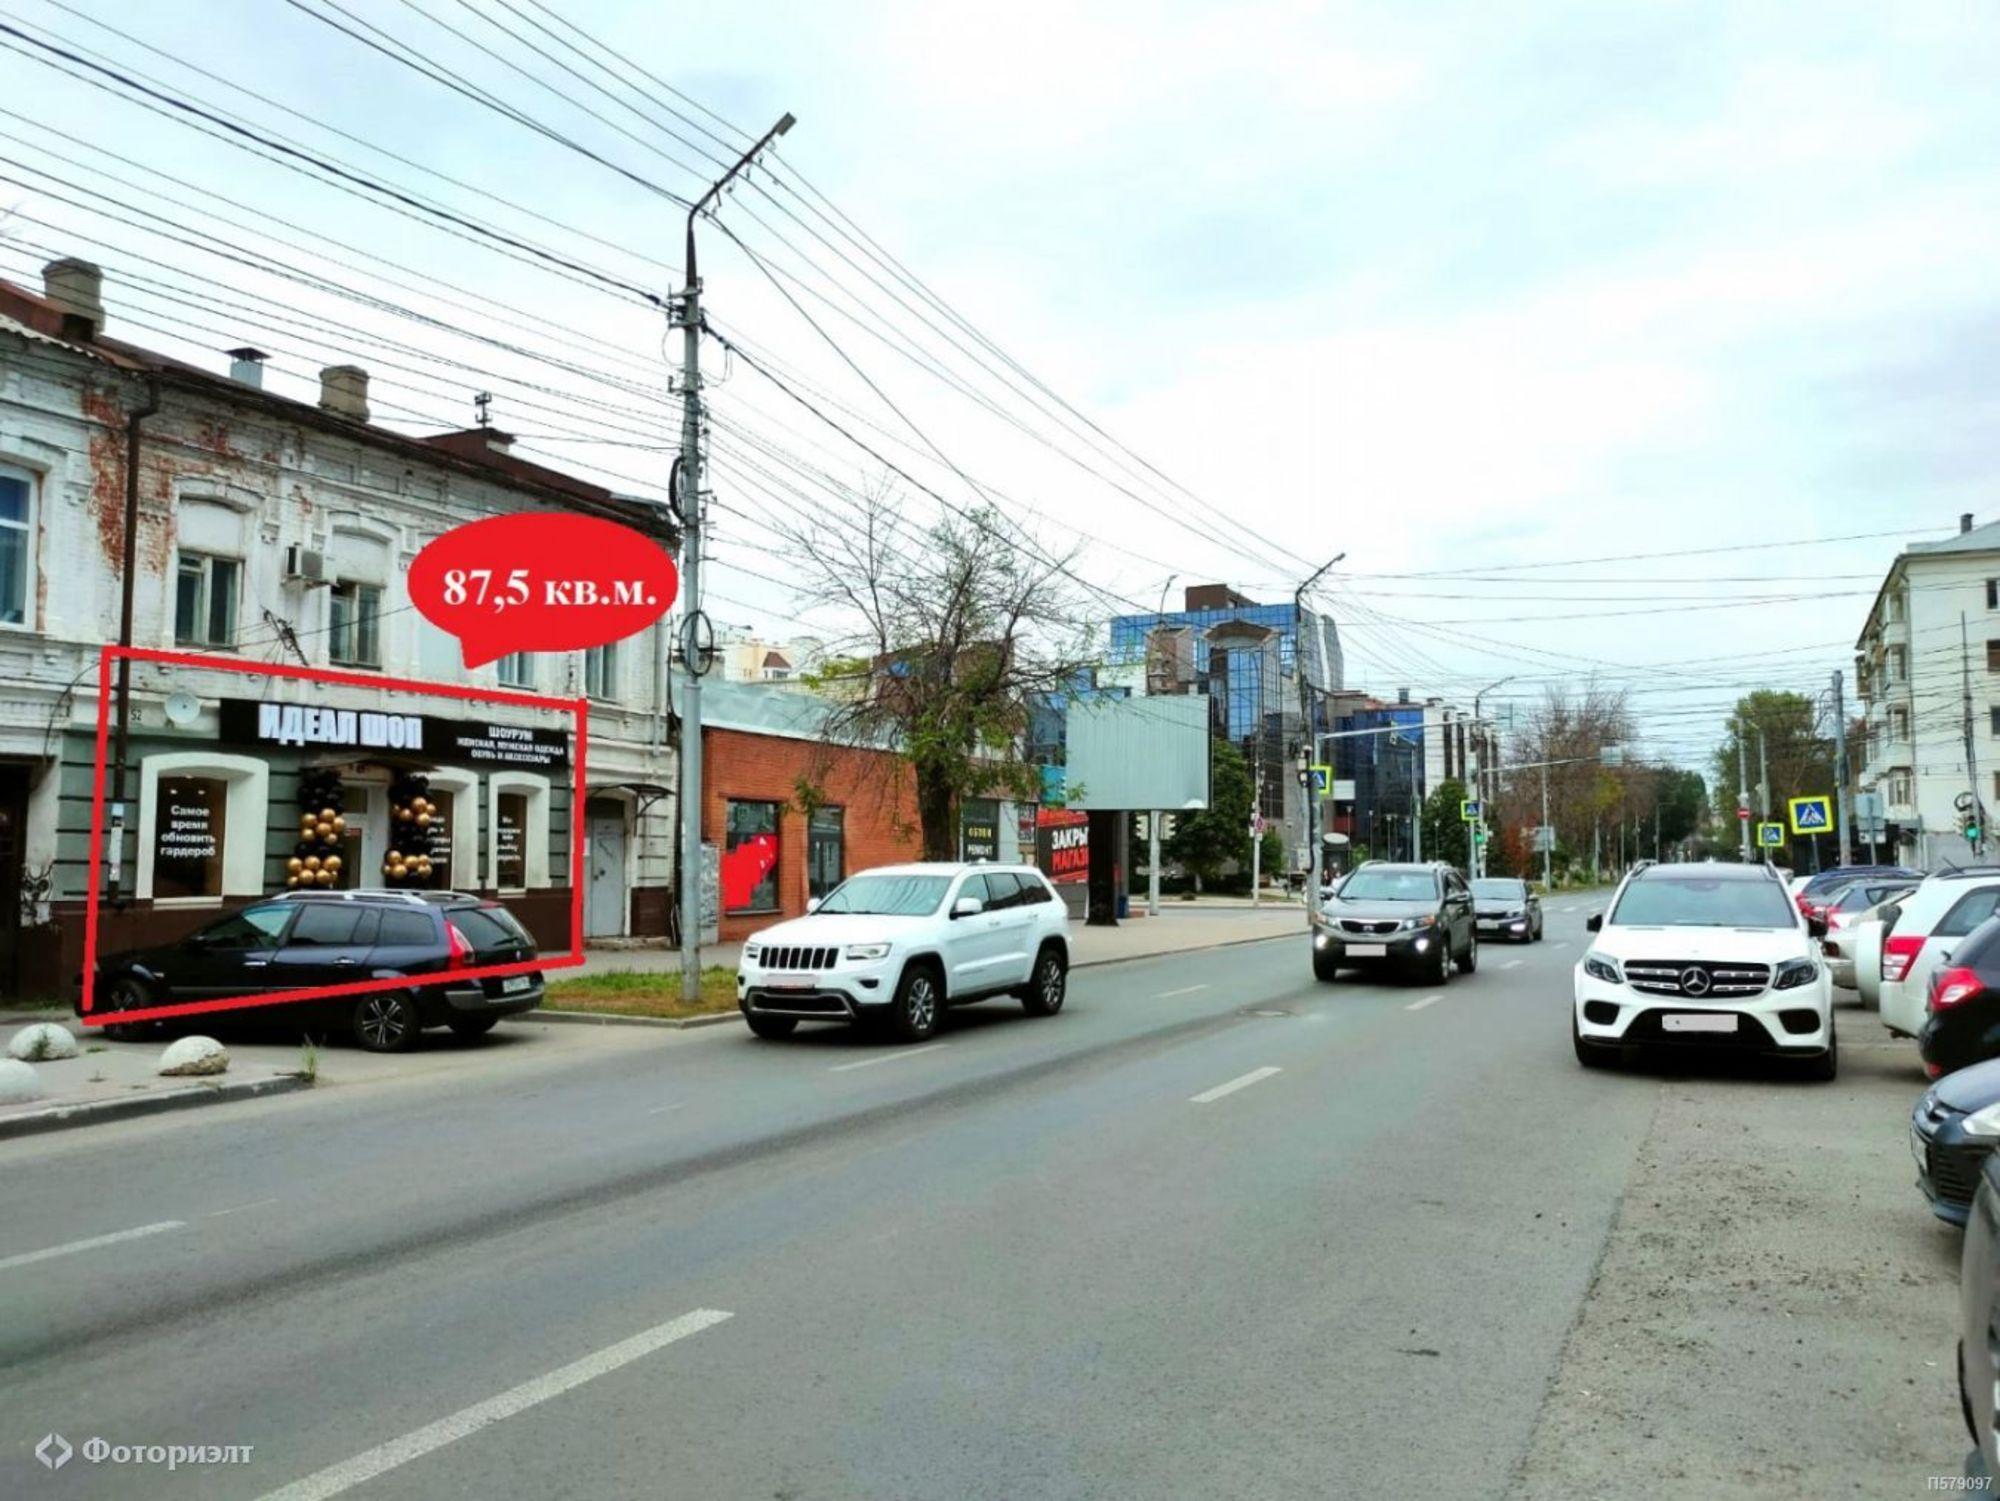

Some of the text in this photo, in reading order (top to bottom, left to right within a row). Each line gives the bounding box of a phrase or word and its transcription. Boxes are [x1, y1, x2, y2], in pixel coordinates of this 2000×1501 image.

[258, 703, 423, 749] ИДЕАЛ ШОП
[488, 725, 534, 741] ШОУРУМ
[170, 805, 210, 817] Самое
[170, 820, 208, 831] время
[160, 831, 216, 843] обновить
[160, 846, 216, 859] гардероб
